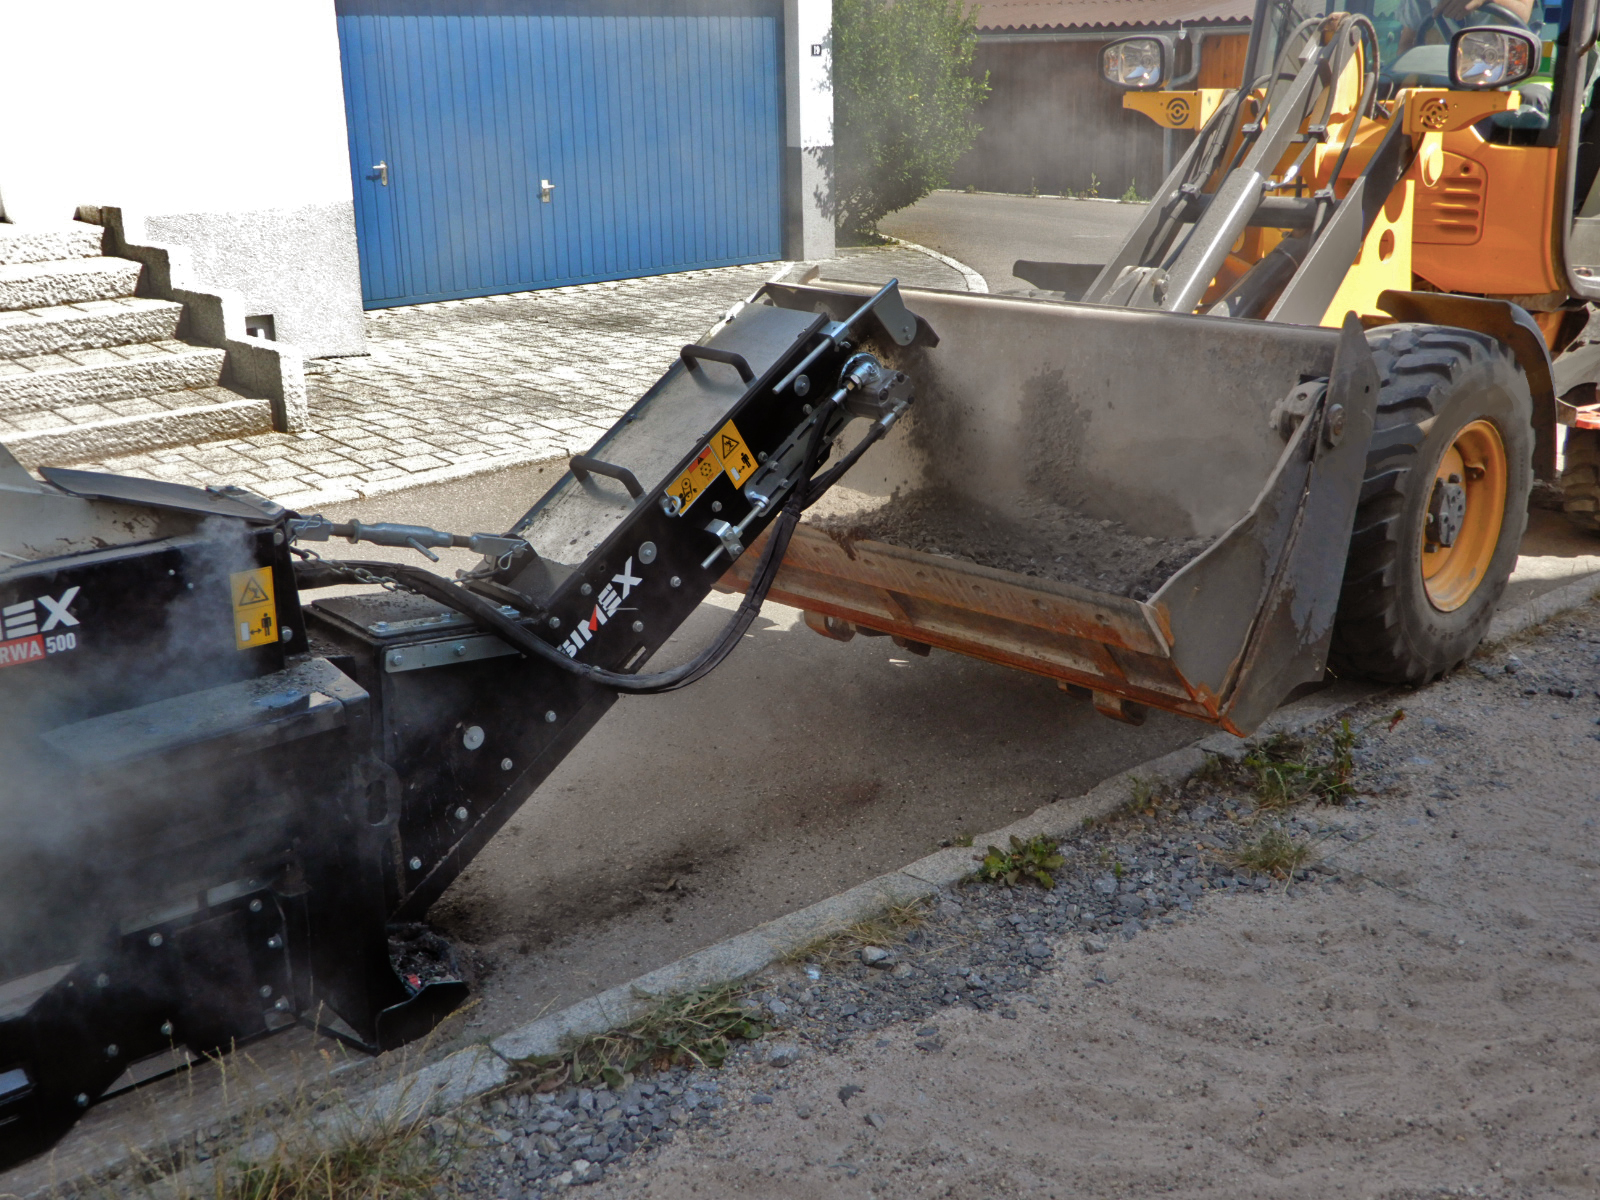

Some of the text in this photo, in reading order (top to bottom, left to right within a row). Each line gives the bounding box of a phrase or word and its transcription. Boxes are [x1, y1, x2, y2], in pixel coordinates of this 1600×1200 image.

[0, 586, 80, 640] EX
[557, 556, 643, 658] SIMEX
[45, 632, 76, 654] 500
